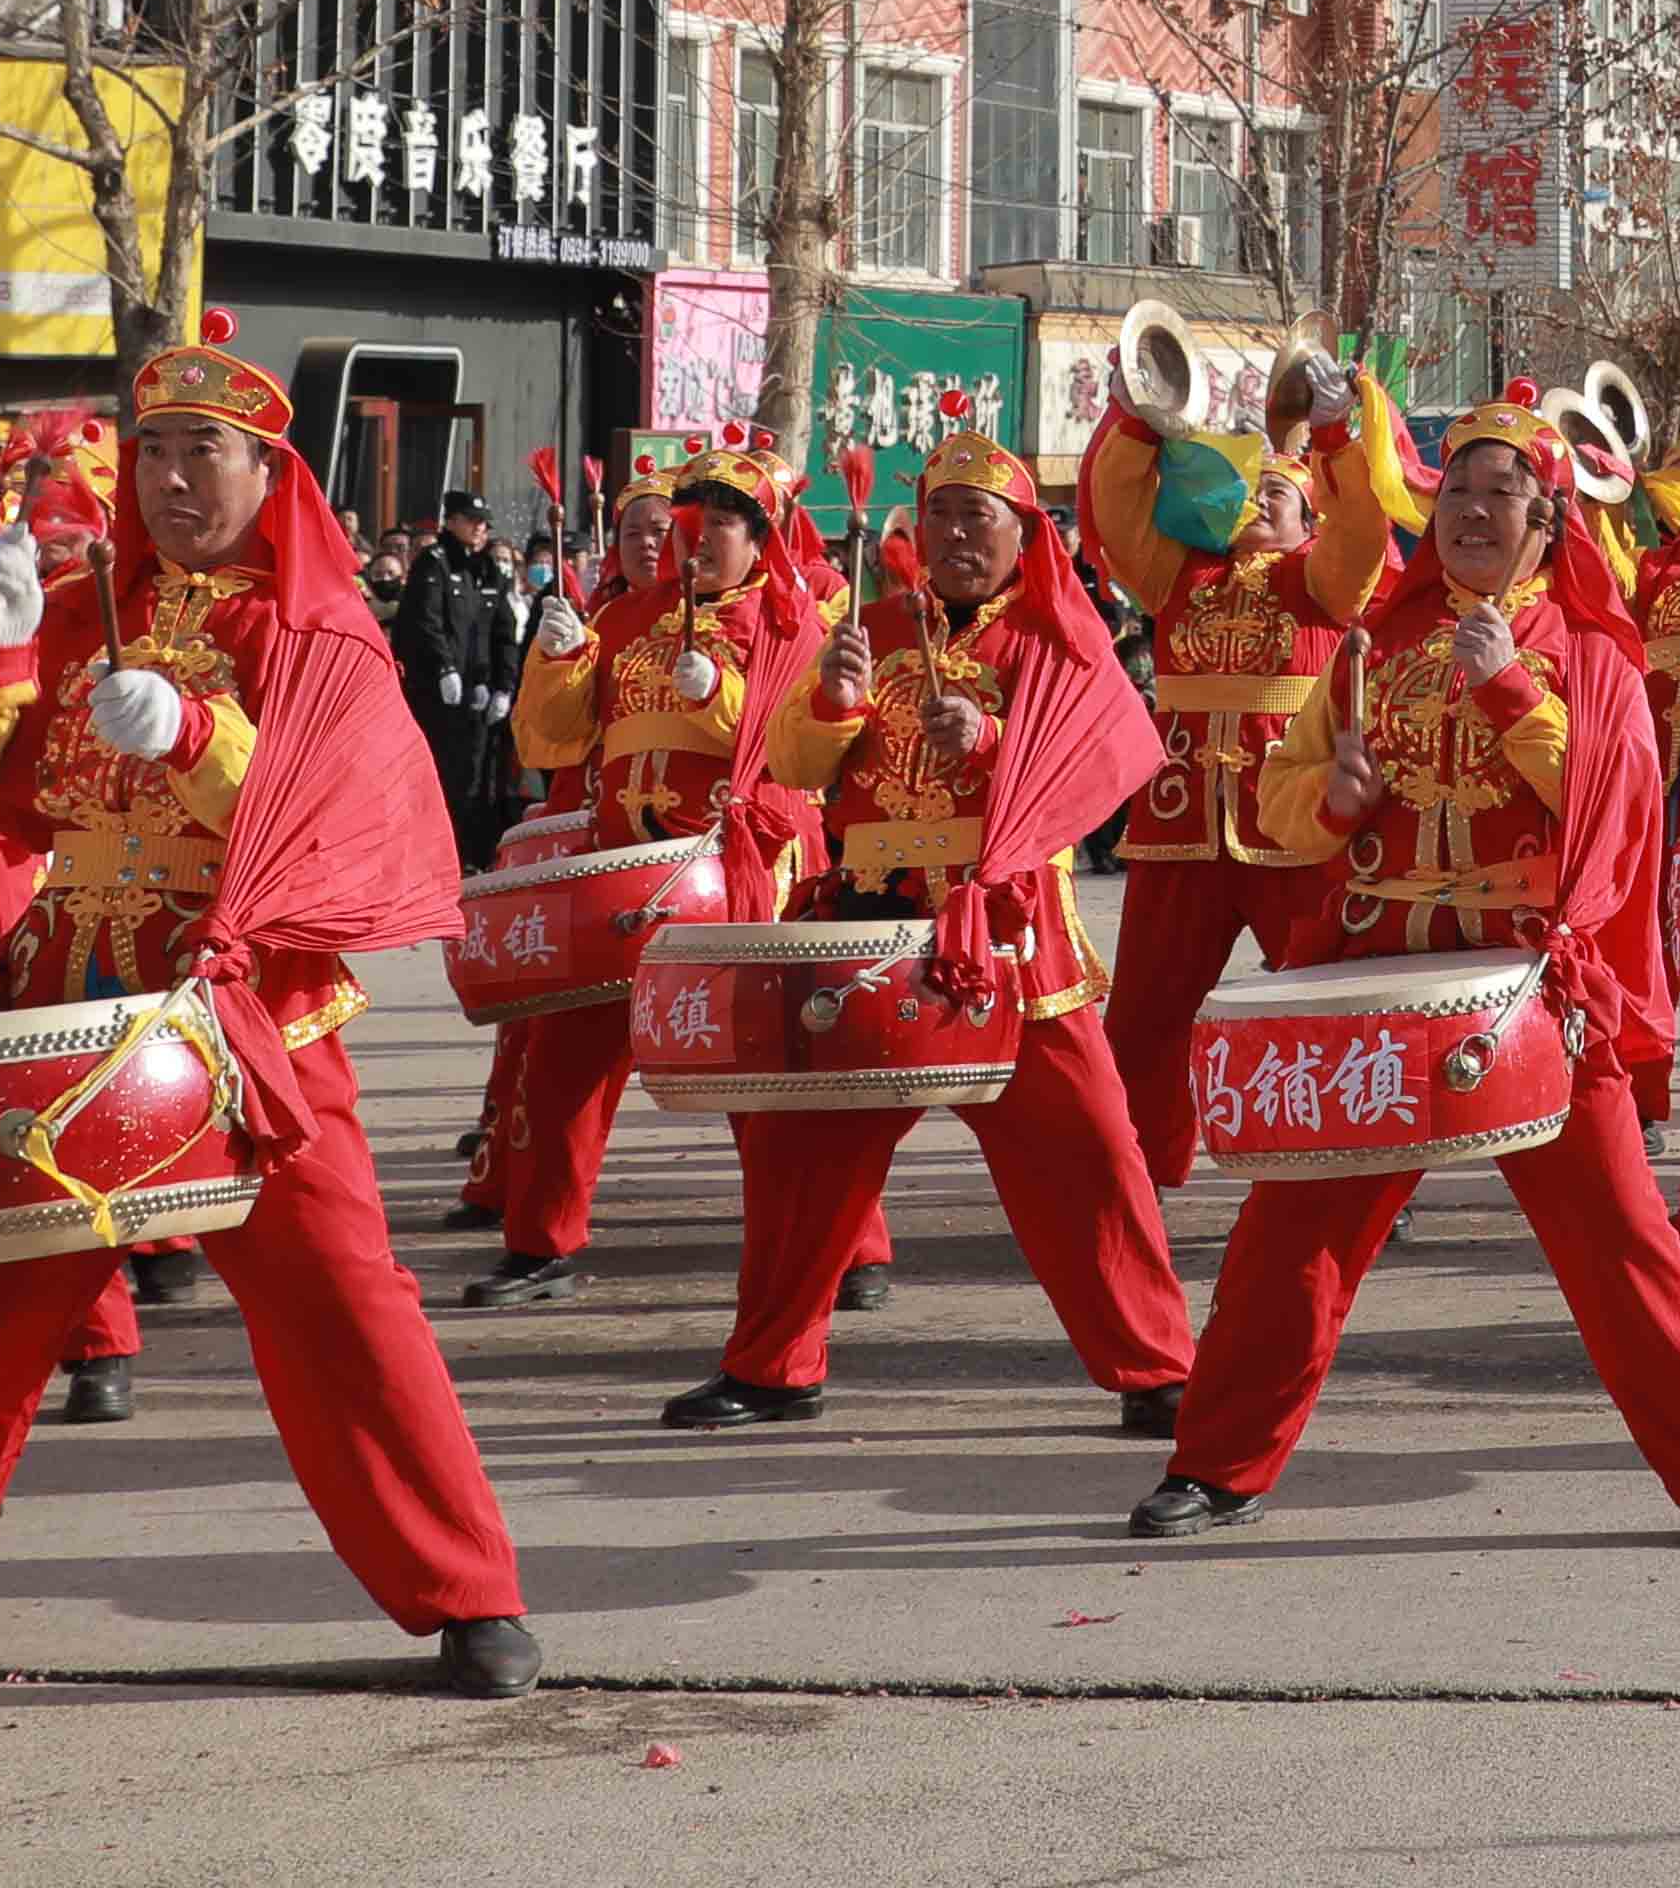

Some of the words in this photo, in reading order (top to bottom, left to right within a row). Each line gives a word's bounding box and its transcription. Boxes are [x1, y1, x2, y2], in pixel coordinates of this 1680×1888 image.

[288, 92, 598, 205] 零度音乐餐厅
[446, 904, 559, 969] 城镇
[1190, 1029, 1419, 1137] 马铺镇
